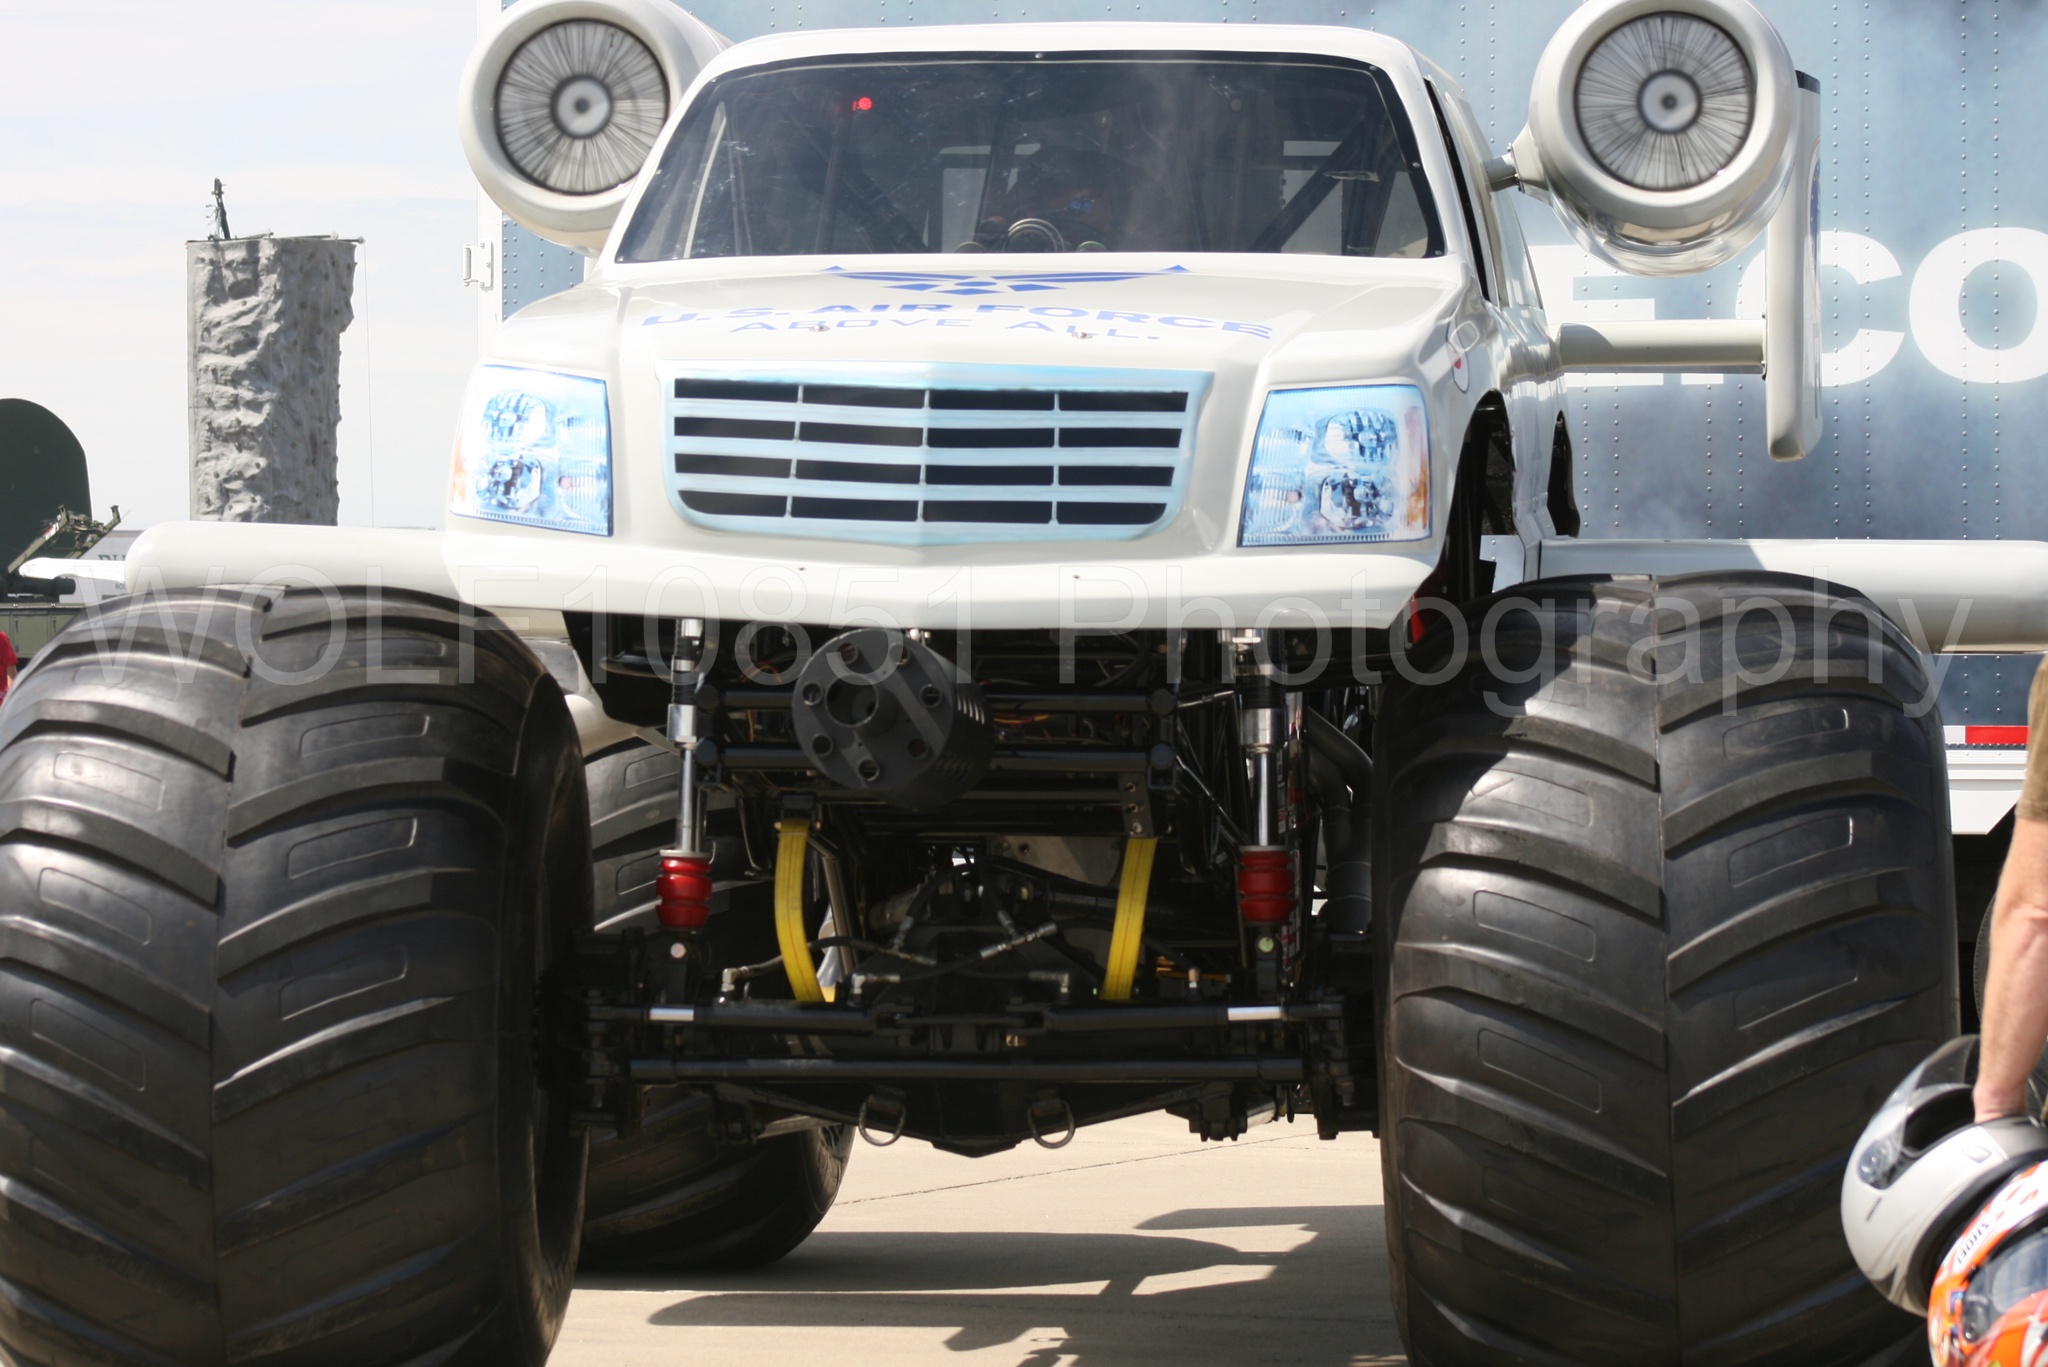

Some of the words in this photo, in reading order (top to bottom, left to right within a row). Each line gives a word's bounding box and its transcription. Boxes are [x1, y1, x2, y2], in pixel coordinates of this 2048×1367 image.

[641, 307, 791, 326] U.S.
[806, 303, 953, 315] AIR
[975, 304, 1274, 340] FORCE
[727, 318, 973, 333] ABOVE
[1524, 226, 2048, 388] ECO
